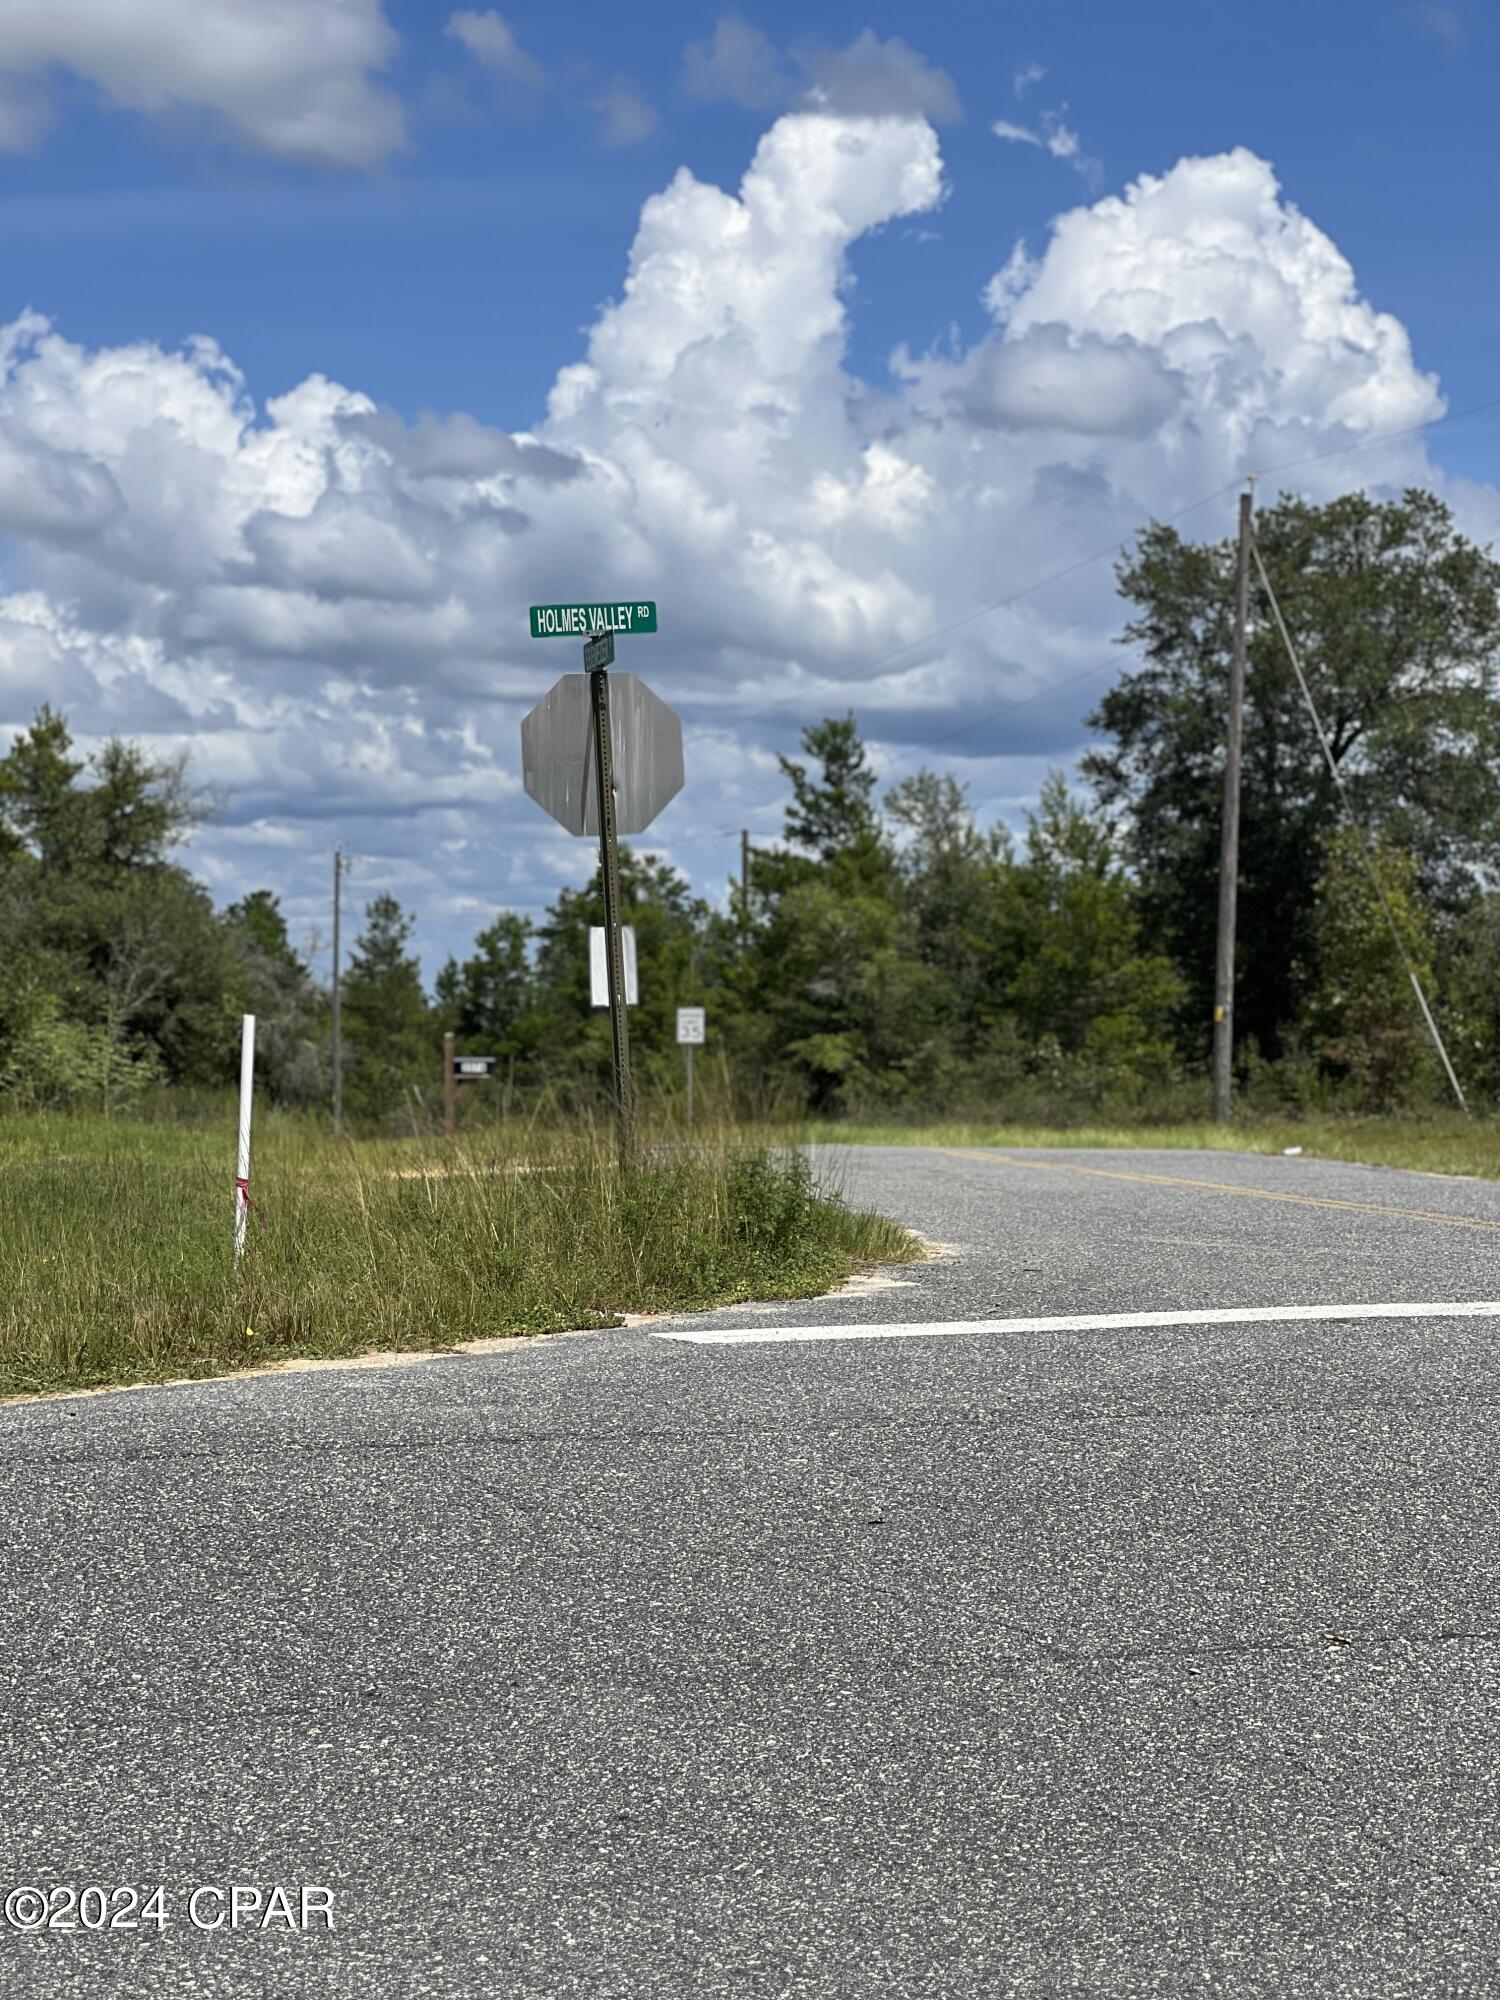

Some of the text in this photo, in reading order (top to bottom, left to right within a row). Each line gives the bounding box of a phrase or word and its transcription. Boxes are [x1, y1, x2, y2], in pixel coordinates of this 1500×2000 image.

[537, 605, 650, 632] HOLMES VALLEY RD
